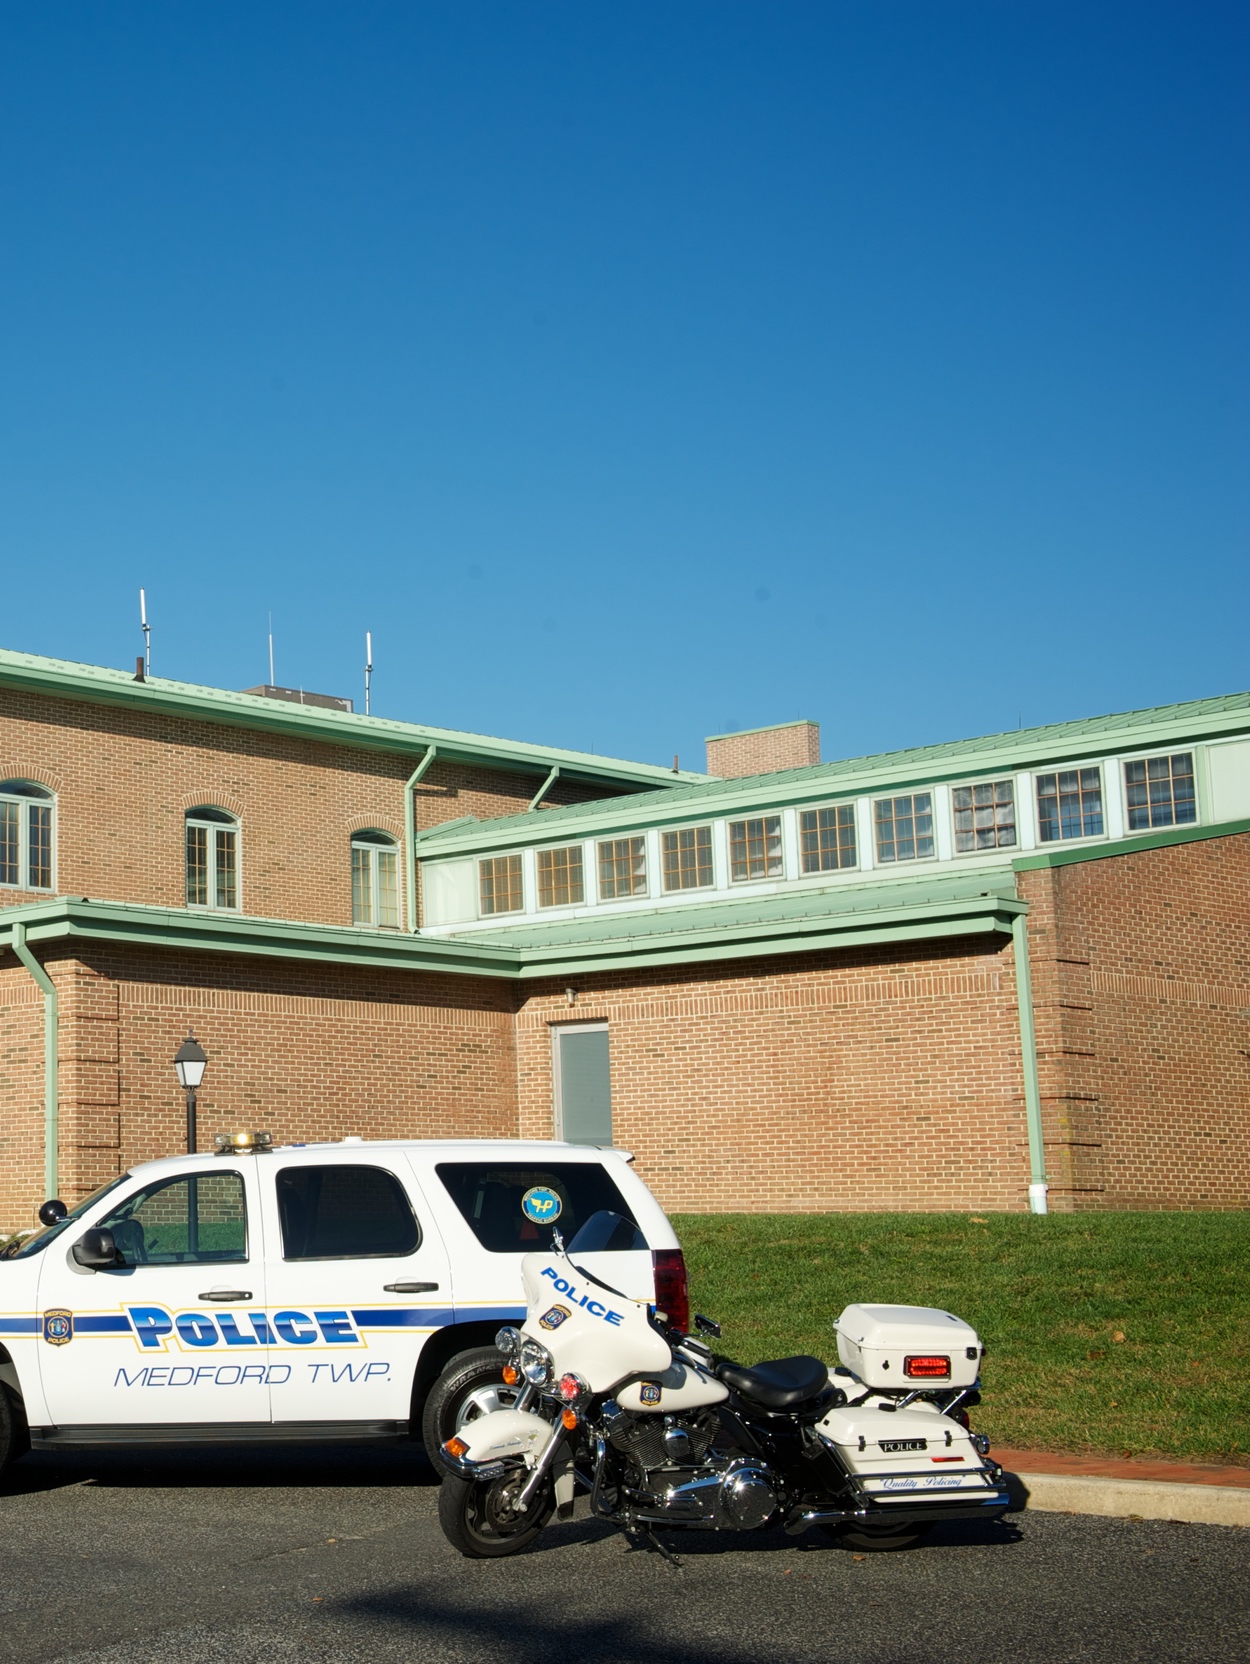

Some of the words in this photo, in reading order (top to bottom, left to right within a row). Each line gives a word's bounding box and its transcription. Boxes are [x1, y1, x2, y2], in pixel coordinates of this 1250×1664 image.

[540, 1266, 625, 1327] POLICE
[127, 1306, 360, 1348] POLICE
[114, 1364, 292, 1387] MEDFORD
[307, 1362, 392, 1384] TWP.
[884, 1442, 923, 1452] POLICE
[880, 1478, 918, 1490] "Quality
[923, 1474, 966, 1487] Policing"
